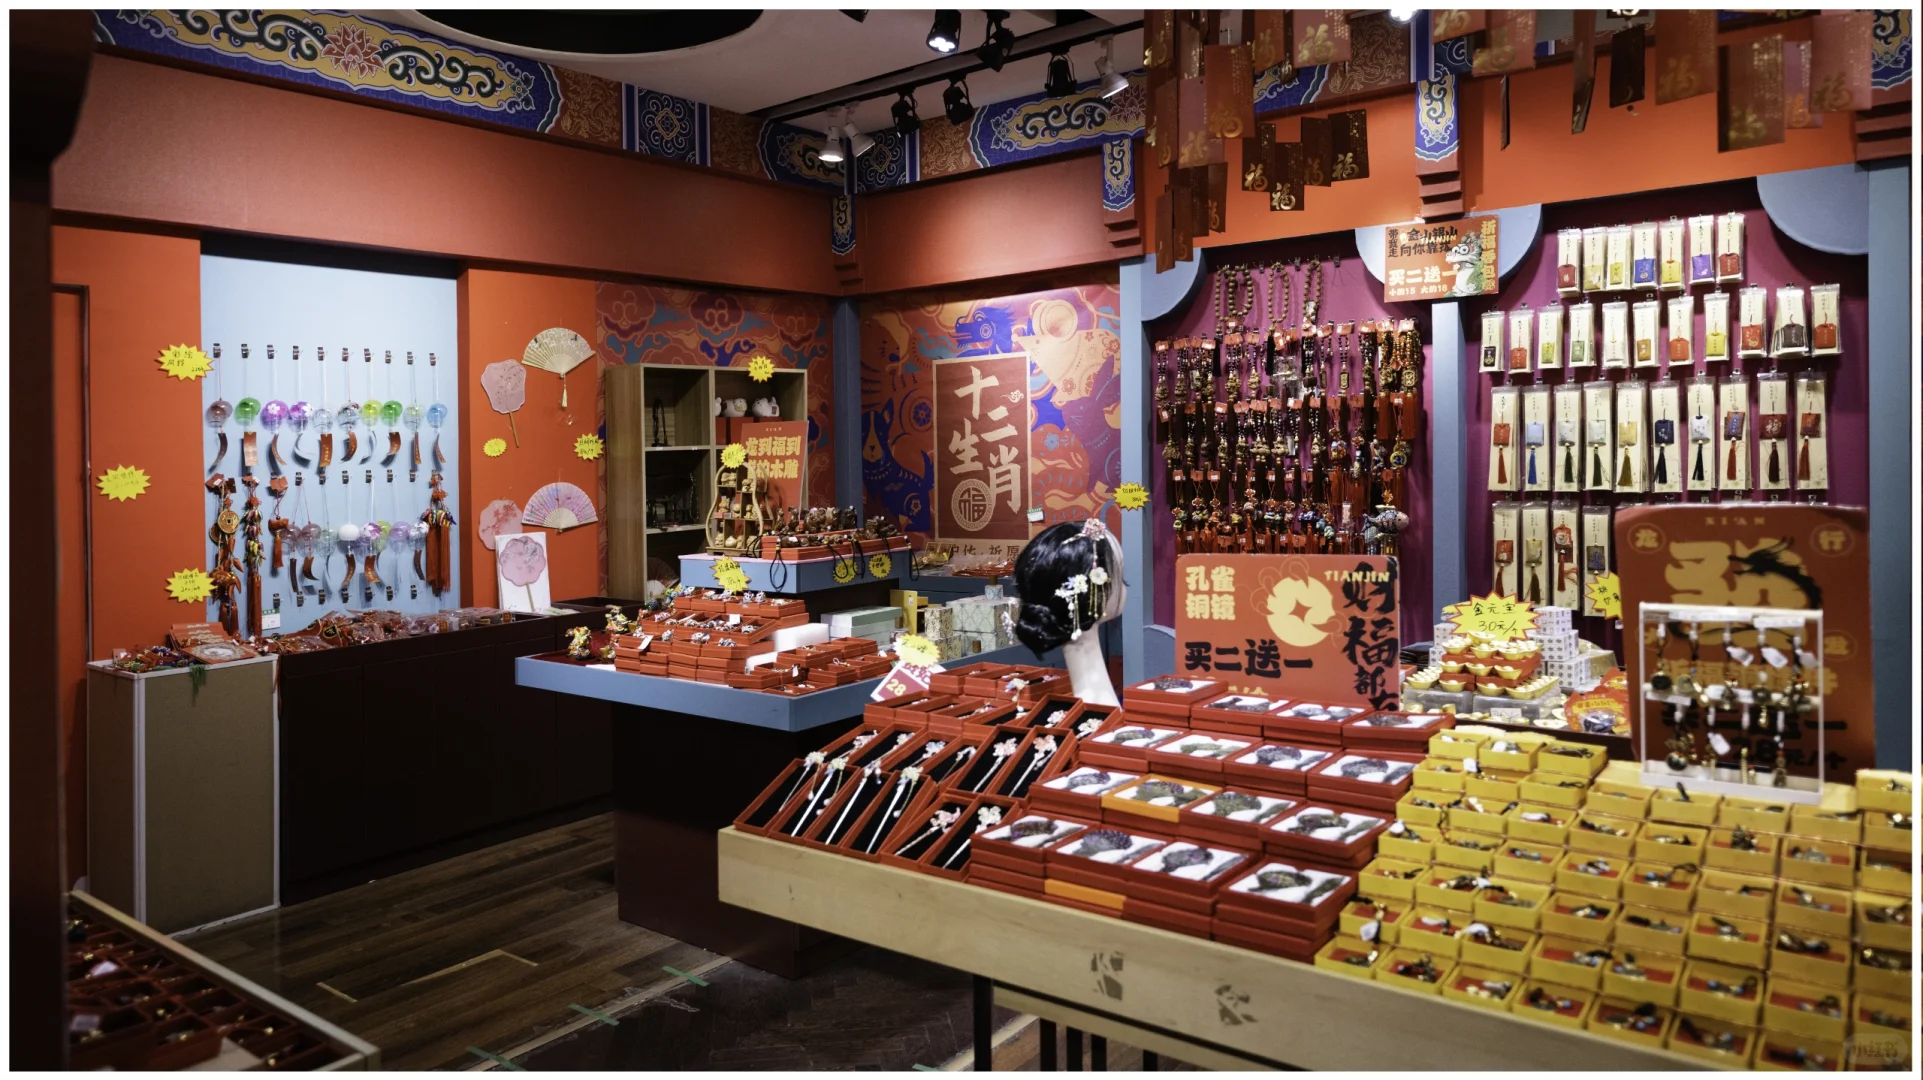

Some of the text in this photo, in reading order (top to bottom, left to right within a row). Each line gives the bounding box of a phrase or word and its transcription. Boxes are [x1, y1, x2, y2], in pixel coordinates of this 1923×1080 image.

[1332, 152, 1359, 179] 福
[1245, 163, 1268, 191] 福
[1271, 182, 1296, 210] 福
[1420, 234, 1458, 244] TIANJIN
[1388, 266, 1459, 286] 买二送一
[745, 435, 801, 457] 龙到福到
[948, 365, 1022, 514] 十二生肖
[1818, 530, 1846, 551] 行
[1185, 565, 1236, 592] 孔雀
[1324, 570, 1391, 584] TIANJIN
[1185, 594, 1236, 621] 铜镜
[1473, 602, 1516, 616] 金元宝
[1478, 620, 1518, 635] 30元/个
[1184, 638, 1313, 679] 买二送一
[886, 678, 907, 696] 28
